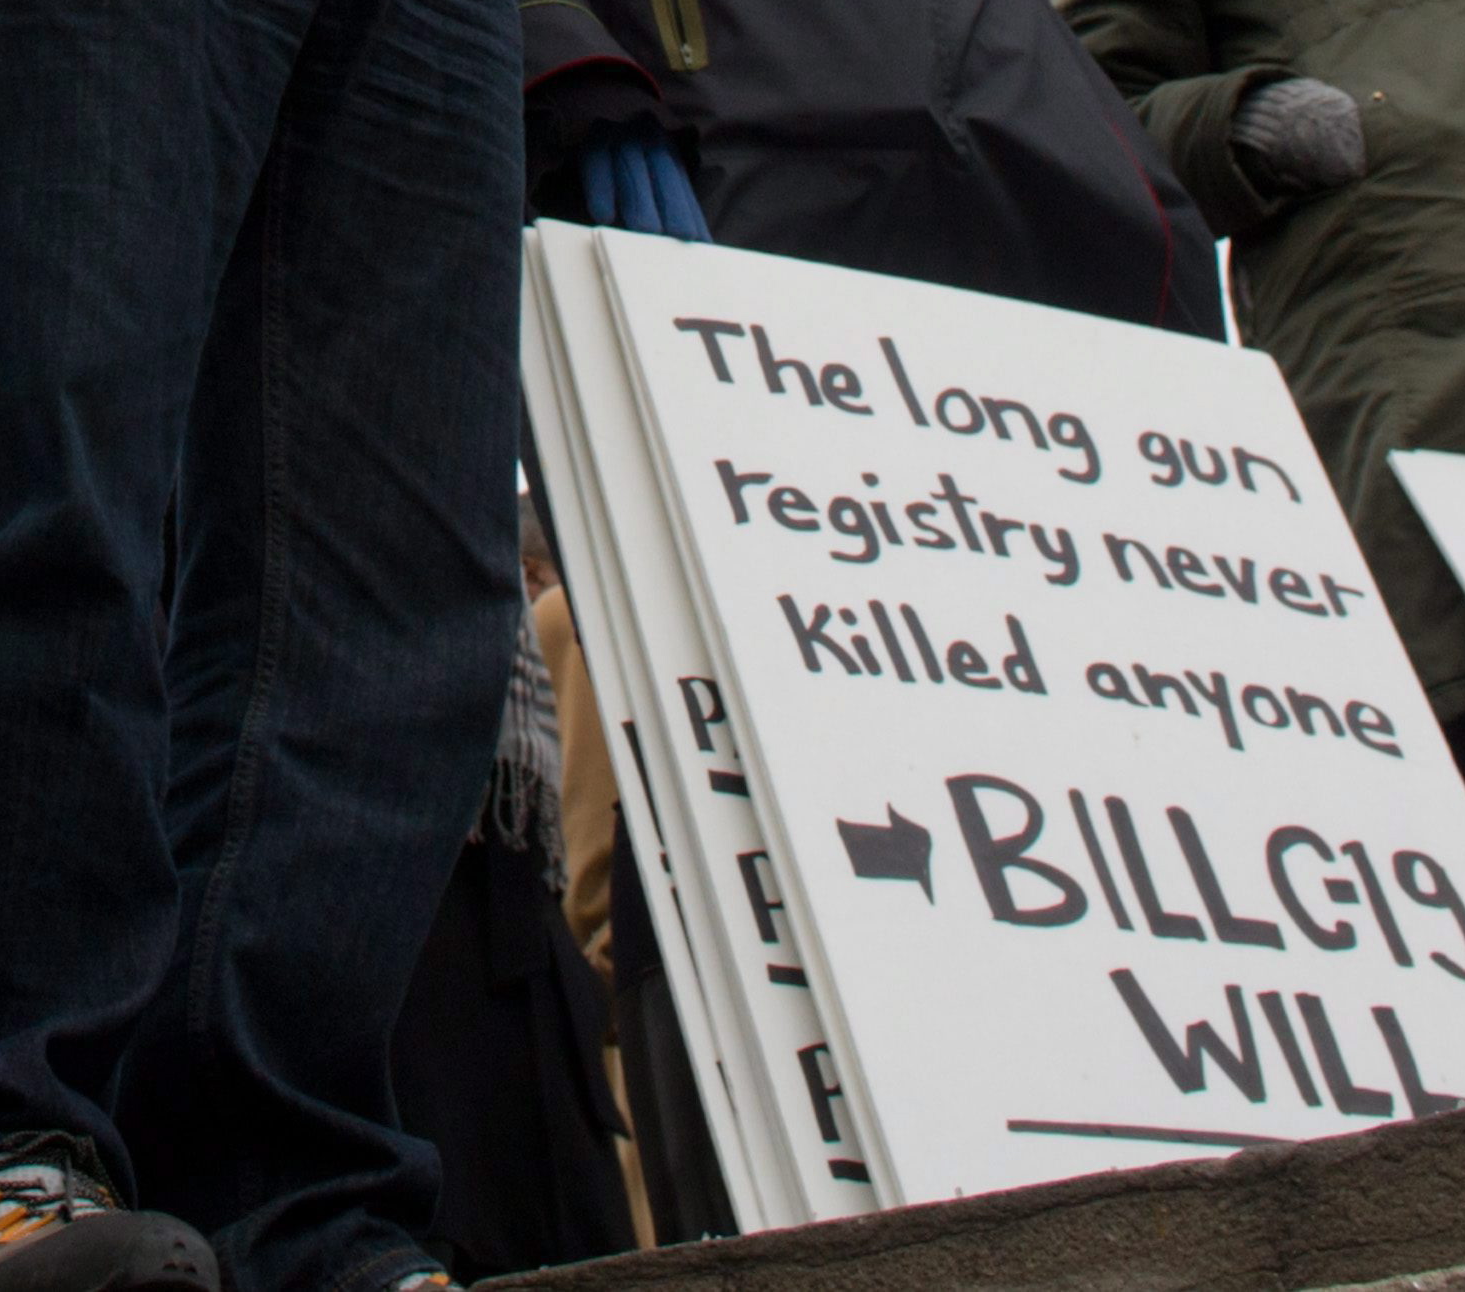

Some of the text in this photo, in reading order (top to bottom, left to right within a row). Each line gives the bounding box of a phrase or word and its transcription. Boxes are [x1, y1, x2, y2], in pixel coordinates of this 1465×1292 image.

[674, 317, 1302, 504] The long gun
[715, 459, 1366, 618] registry never
[1086, 660, 1404, 759] anyone
